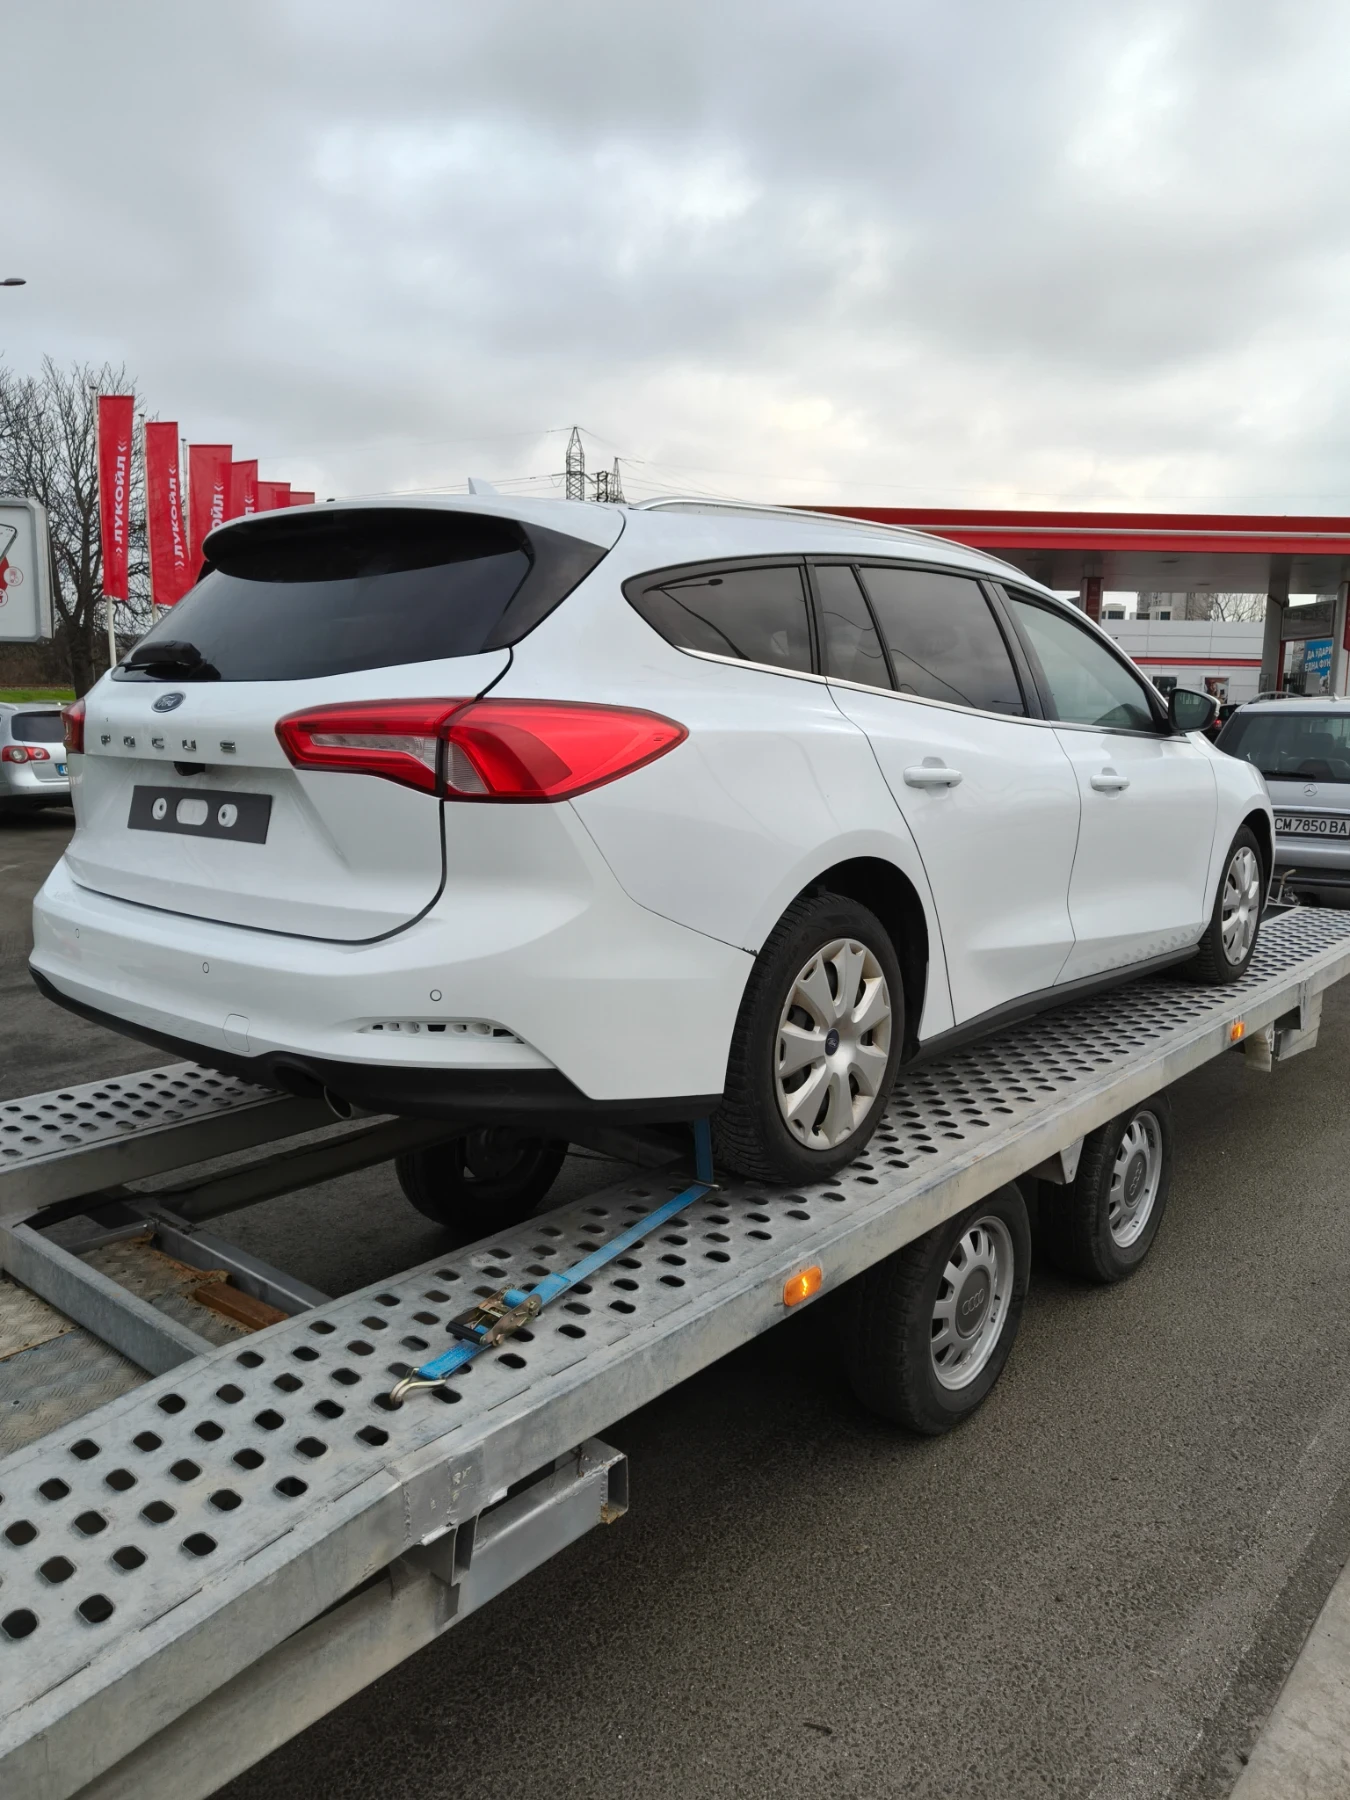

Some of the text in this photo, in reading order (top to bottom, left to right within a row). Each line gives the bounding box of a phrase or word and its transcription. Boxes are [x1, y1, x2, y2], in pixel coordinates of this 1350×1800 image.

[114, 456, 126, 544] ЛУКОЙЛ
[169, 478, 184, 559] ЛУКОЙЛ
[1307, 650, 1315, 660] ДА
[1304, 661, 1319, 673] ЕДНА
[100, 734, 237, 754] FOCUS
[1274, 818, 1347, 834] CM 7850 BA
